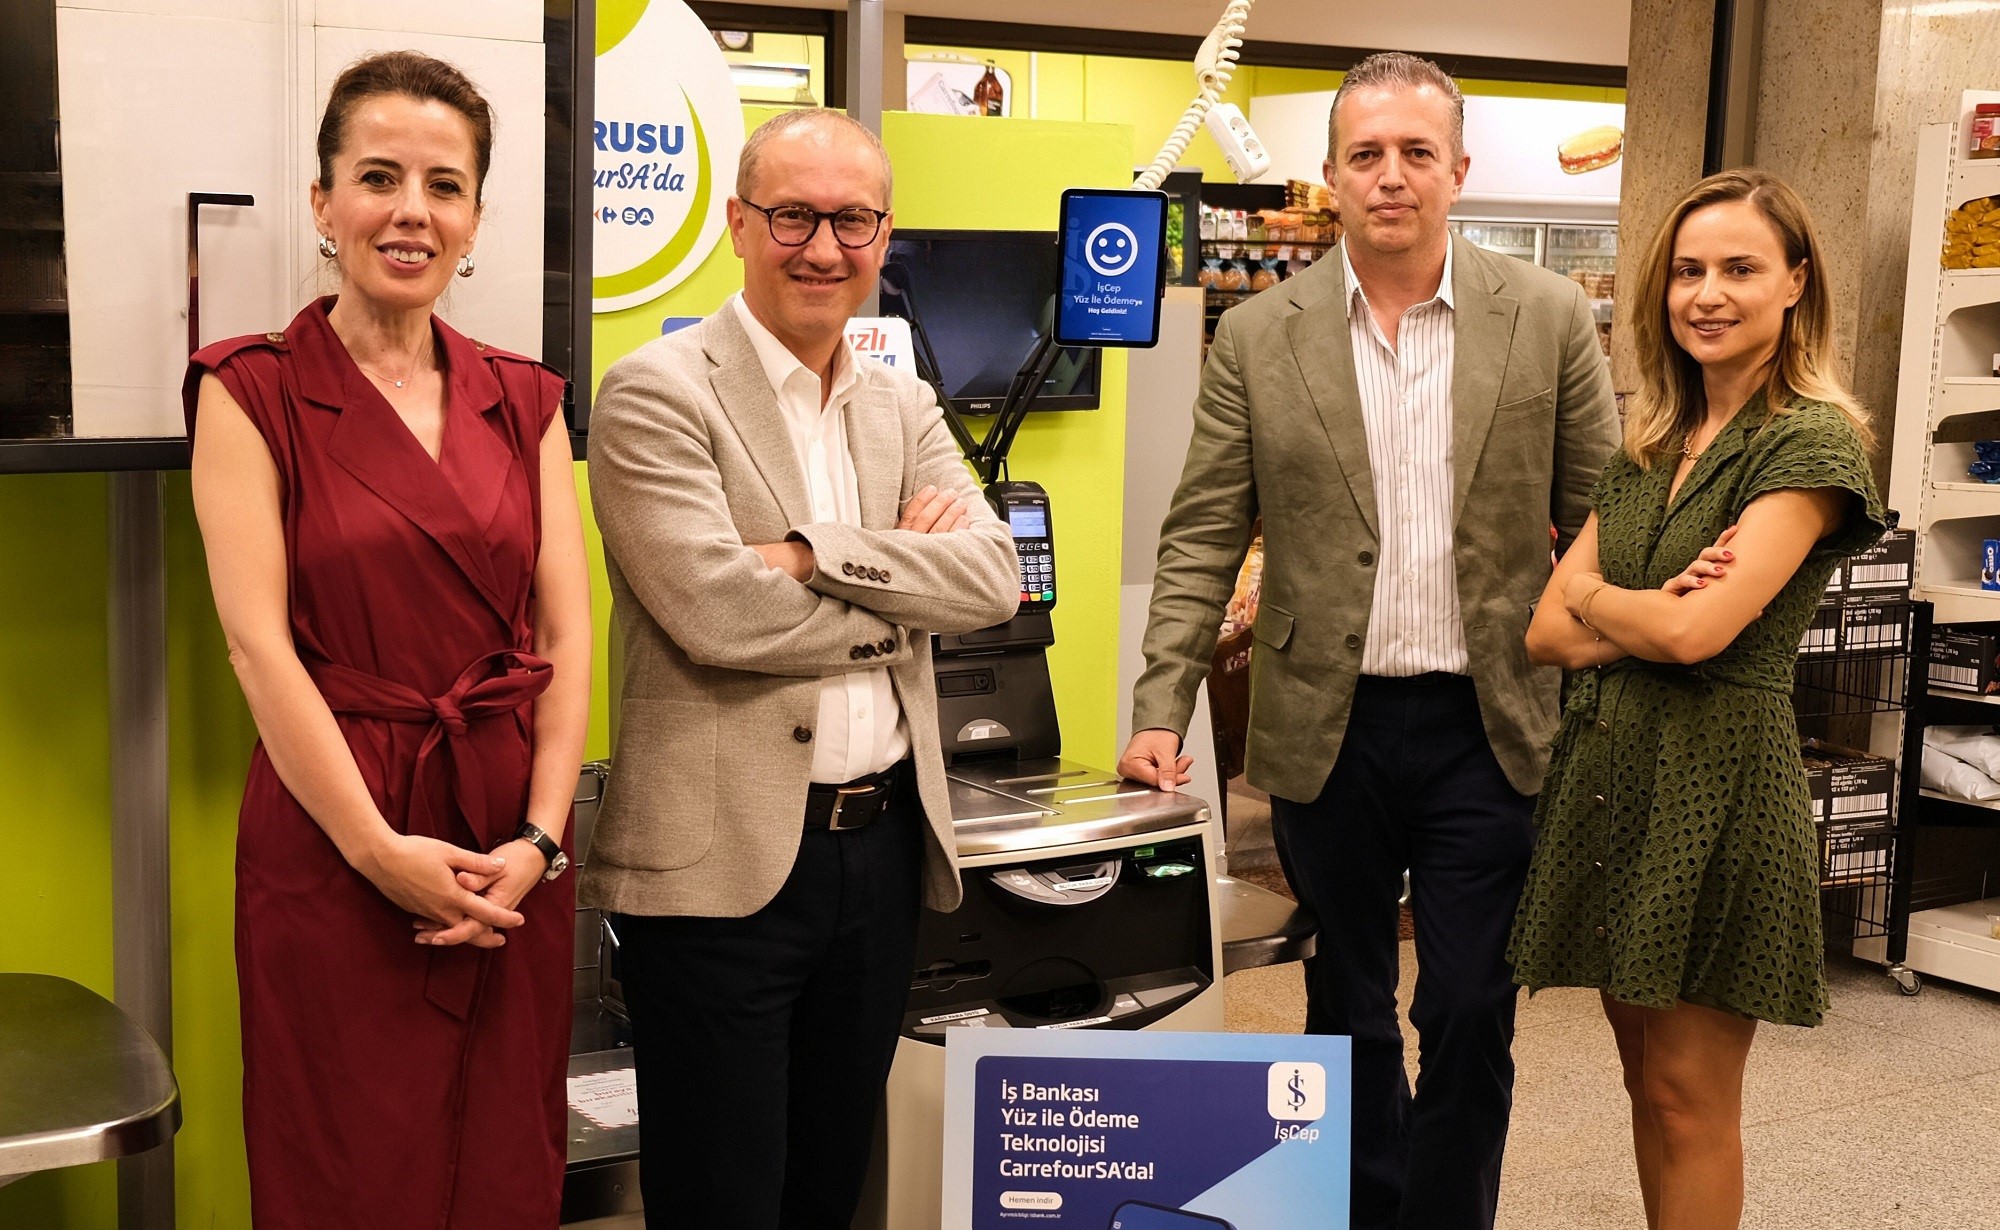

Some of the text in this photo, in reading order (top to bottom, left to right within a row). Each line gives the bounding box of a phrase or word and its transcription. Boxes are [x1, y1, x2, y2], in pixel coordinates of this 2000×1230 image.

[593, 120, 684, 155] RUSU
[623, 209, 653, 223] SA
[1097, 282, 1121, 294] İşCep
[1073, 295, 1089, 304] Yüz
[1001, 1079, 1099, 1104] İş Bankası
[1001, 1106, 1140, 1128] Yüz ile Ödeme
[1274, 1121, 1319, 1144] İşCep
[1000, 1133, 1106, 1157] Teknolojisi
[999, 1159, 1154, 1180] CarrefourSA'da!
[1008, 1196, 1036, 1204] Hemen
